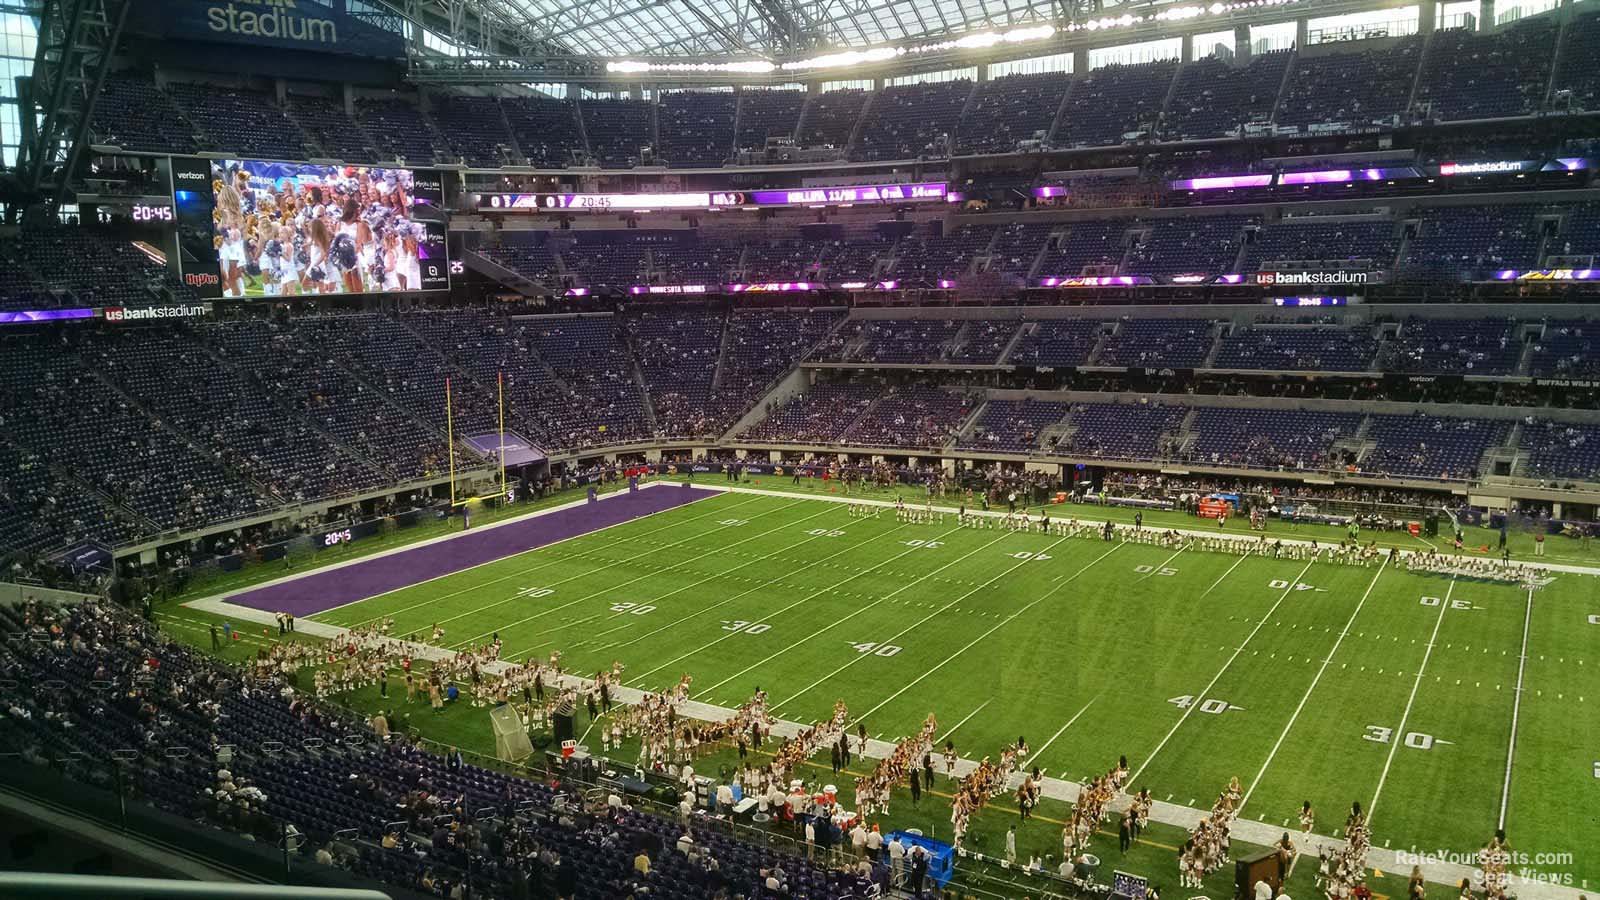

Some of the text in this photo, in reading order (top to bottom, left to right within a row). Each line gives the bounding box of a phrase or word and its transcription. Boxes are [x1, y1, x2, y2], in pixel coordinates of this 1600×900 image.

[208, 3, 337, 43] stadium
[177, 171, 205, 180] verizon
[581, 197, 611, 207] 20:45
[133, 206, 172, 220] 20:45
[451, 261, 464, 274] 25
[1536, 379, 1570, 387] BUFFALO
[610, 602, 656, 615] 20
[722, 621, 772, 634] 30
[852, 642, 903, 657] 40
[1167, 694, 1229, 714] 40
[1362, 725, 1433, 750] 30
